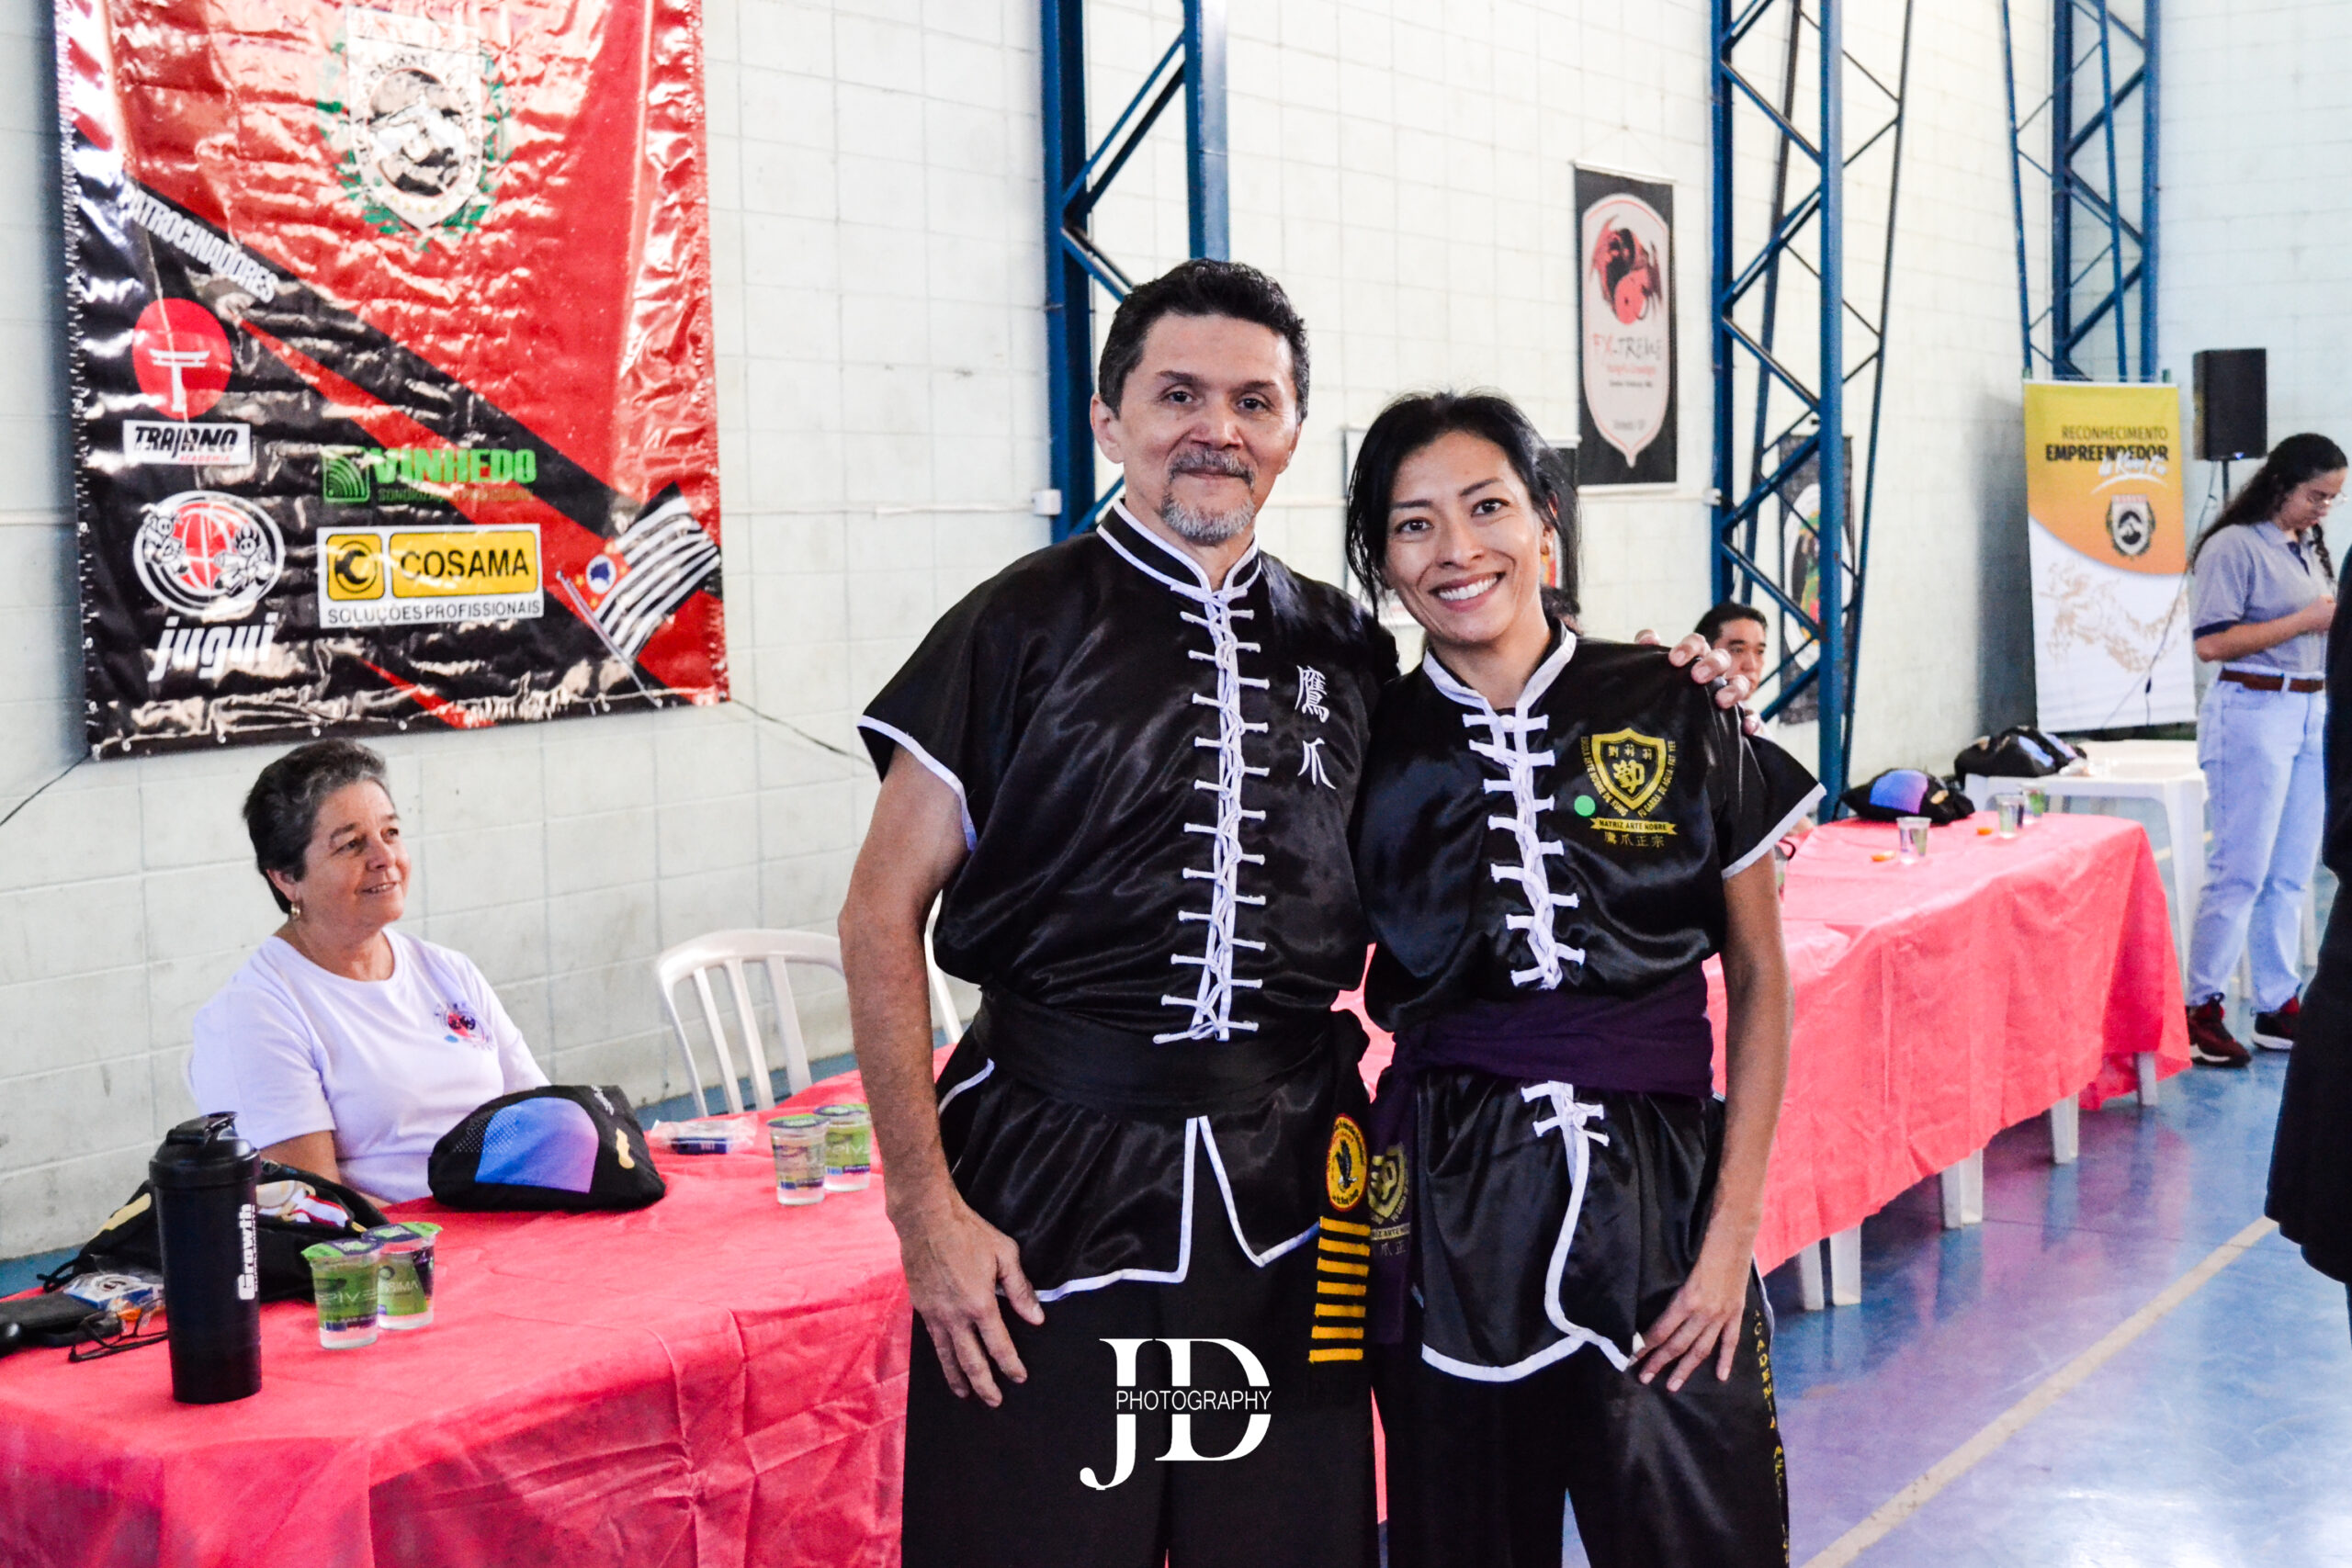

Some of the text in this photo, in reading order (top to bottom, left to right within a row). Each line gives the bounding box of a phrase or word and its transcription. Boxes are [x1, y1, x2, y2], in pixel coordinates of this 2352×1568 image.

[119, 186, 278, 303] PATROCINADORES
[2062, 425, 2168, 440] RECONHECIMENTO
[370, 447, 537, 484] VINHEDO
[2046, 445, 2168, 461] EMPREENDEDOR
[401, 548, 529, 581] COSAMA
[328, 599, 541, 626] SOLUÇÕES PROFISSIONAIS
[147, 612, 278, 682] jugui
[1295, 665, 1336, 790] 鷹爪
[1600, 819, 1624, 829] MATRIZ
[1625, 822, 1644, 830] ARTE
[238, 1204, 255, 1300] Growth
